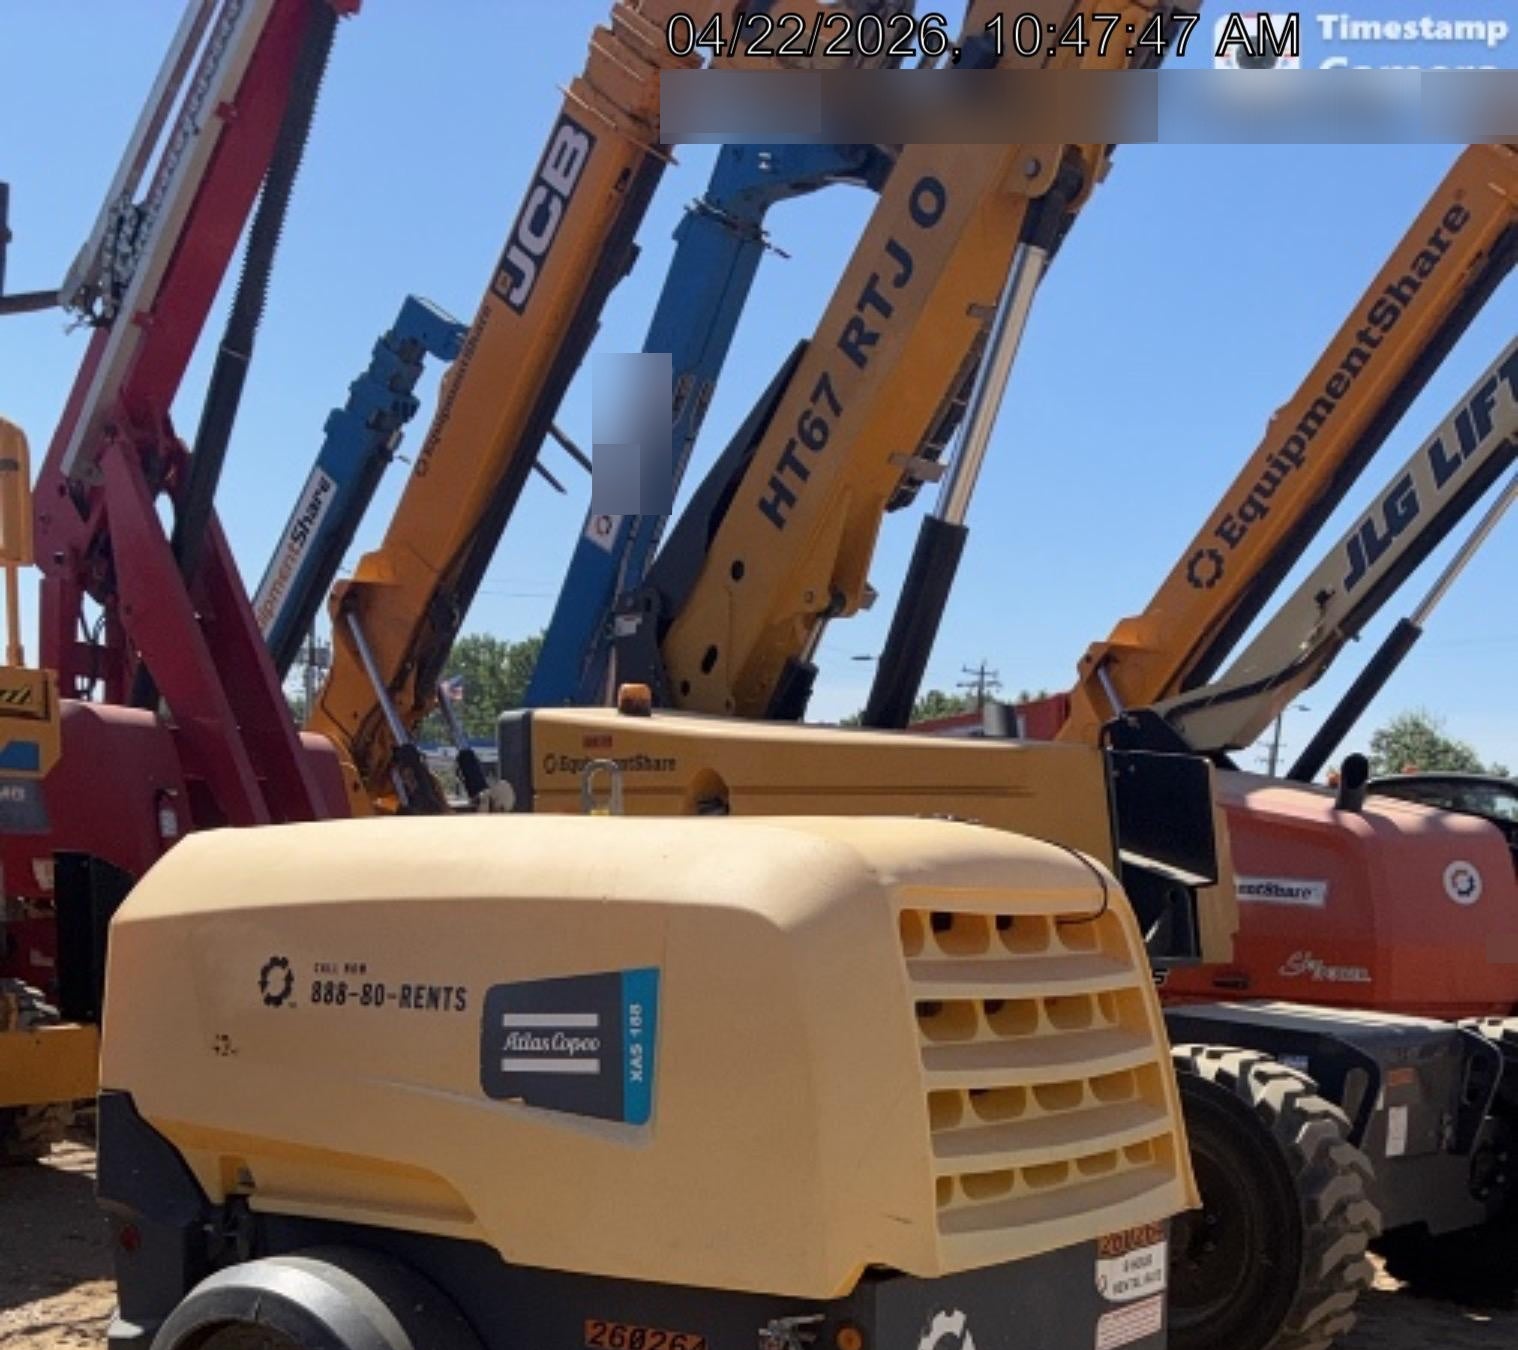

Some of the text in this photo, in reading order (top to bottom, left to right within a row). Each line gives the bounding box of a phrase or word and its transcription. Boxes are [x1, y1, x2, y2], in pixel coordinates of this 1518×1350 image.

[504, 123, 594, 308] JCB
[758, 371, 844, 530] HT67
[837, 238, 914, 370] RTJ
[1213, 202, 1472, 549] EquipmentShare
[1343, 474, 1421, 592] JLG
[311, 980, 468, 1012] 888-80-RENTS
[503, 1032, 600, 1056] Atlas Copco
[630, 1043, 644, 1082] XAS
